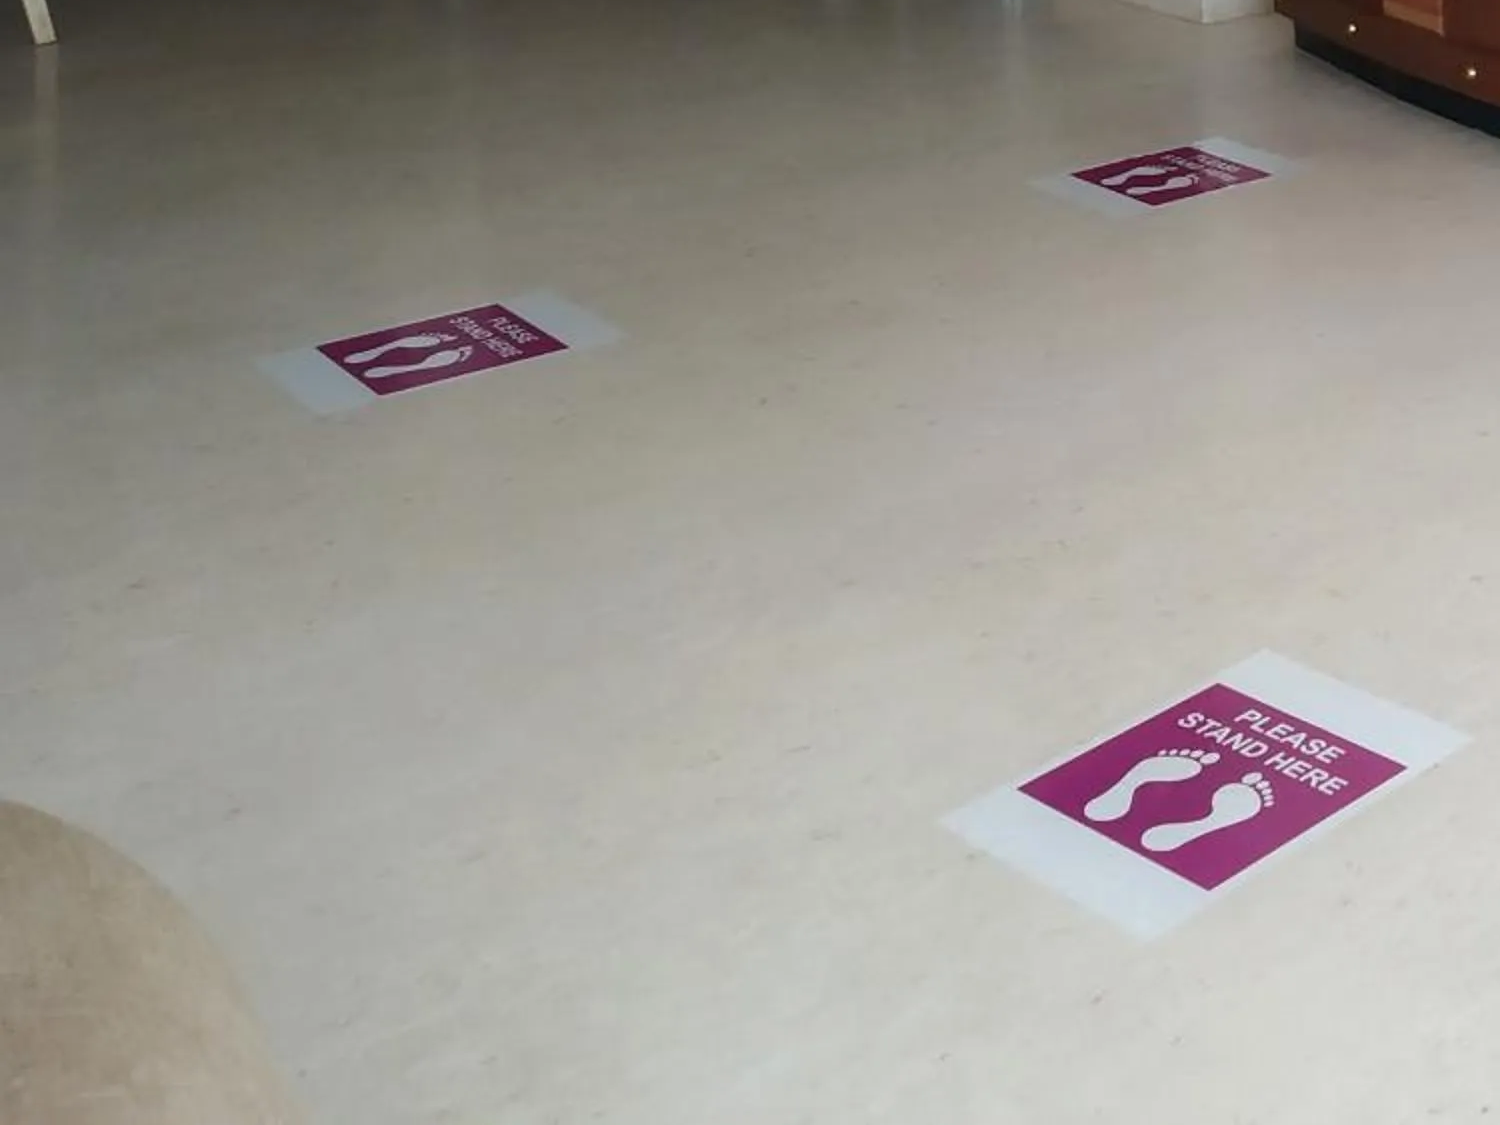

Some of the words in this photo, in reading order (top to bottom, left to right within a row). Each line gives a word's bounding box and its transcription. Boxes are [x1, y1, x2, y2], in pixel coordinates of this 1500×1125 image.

[1177, 712, 1269, 758] STAND
[1264, 752, 1349, 795] HERE
[1233, 709, 1346, 764] PLEASE
